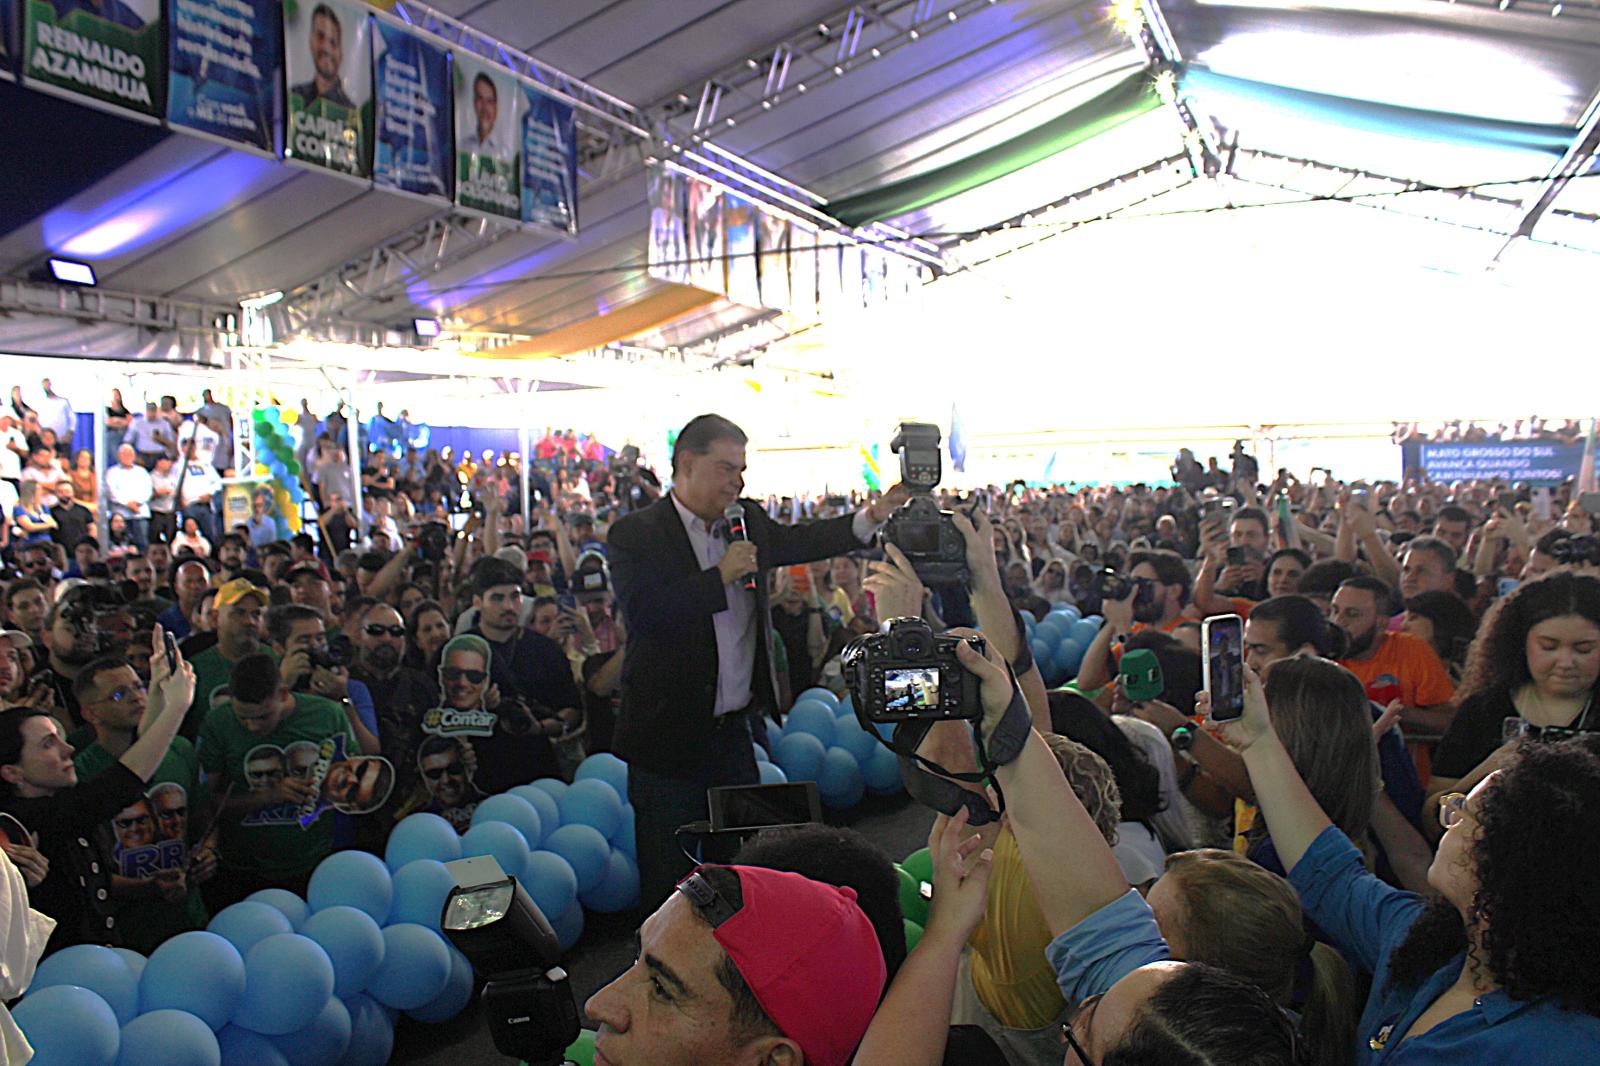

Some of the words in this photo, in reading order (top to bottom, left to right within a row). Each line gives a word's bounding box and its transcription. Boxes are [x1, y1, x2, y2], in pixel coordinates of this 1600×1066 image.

[36, 21, 145, 79] REINALDO
[31, 47, 152, 106] AZAMBUJA
[1427, 447, 1460, 458] MATO
[1462, 446, 1511, 457] GROSSO
[1512, 446, 1532, 457] DO
[1533, 446, 1554, 457] SUL
[1476, 458, 1531, 469] QUANDO
[425, 709, 496, 727] #Contar
